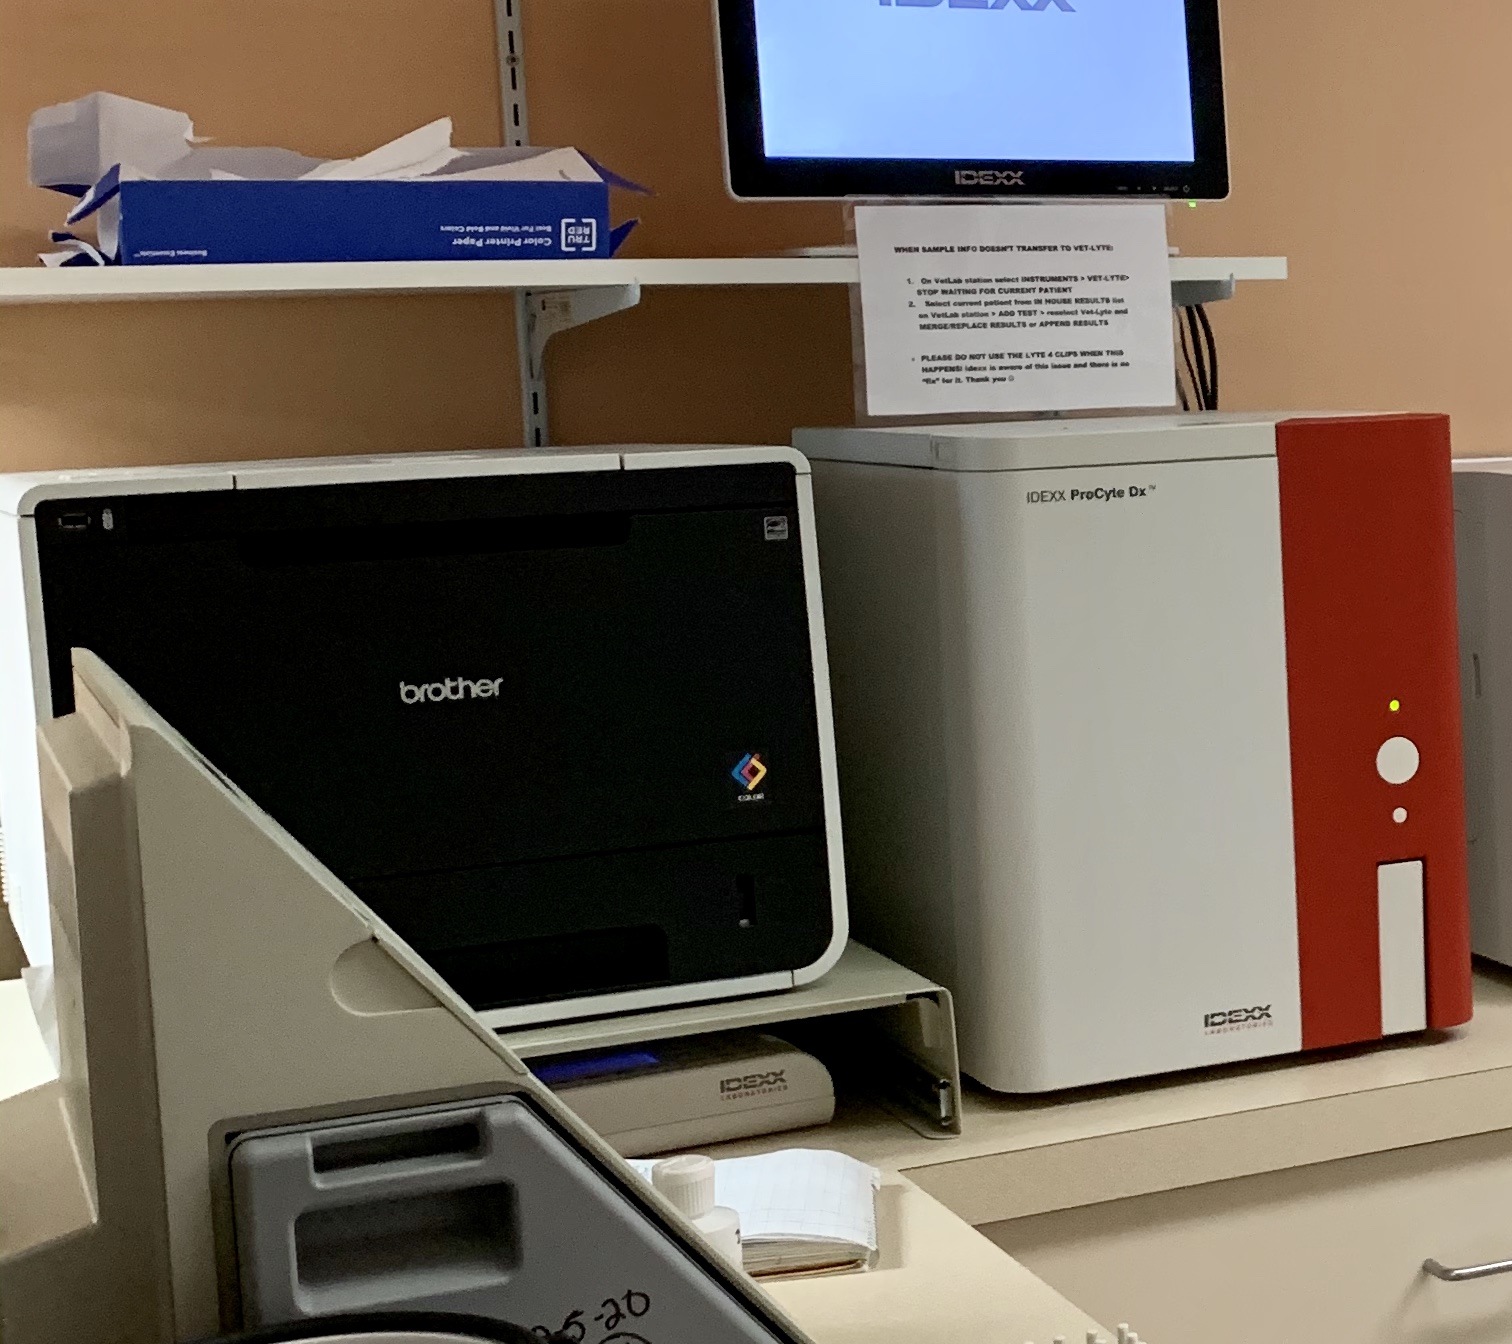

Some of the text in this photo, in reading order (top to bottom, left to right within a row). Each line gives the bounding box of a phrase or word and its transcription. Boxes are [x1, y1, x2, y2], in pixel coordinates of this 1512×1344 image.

[954, 170, 1026, 186] IDEXX
[567, 225, 591, 235] RED
[452, 236, 553, 248] Color Printer Paper
[567, 235, 591, 244] TRU
[894, 246, 920, 254] WHEN
[957, 245, 978, 253] INFO
[979, 245, 1014, 253] DOESN'T
[1060, 244, 1072, 252] TO
[920, 277, 932, 285] On
[1020, 275, 1079, 283] INSTRUMENTS
[916, 288, 939, 296] STOP
[979, 287, 996, 295] FOR
[997, 287, 1037, 295] CURRENT
[1038, 286, 1073, 294] PATIENT
[984, 299, 1012, 307] patient
[1044, 297, 1073, 305] HOUSE
[998, 309, 1016, 317] ADD
[1114, 307, 1129, 315] and
[990, 321, 1027, 329] RESULTS
[1039, 320, 1071, 328] APPEND
[921, 354, 953, 362] PLEASE
[1025, 351, 1046, 359] LYTE
[1055, 350, 1079, 358] CLIPS
[1034, 362, 1049, 370] this
[1073, 361, 1088, 369] and
[965, 375, 990, 383] Thank
[992, 376, 1007, 384] you
[1026, 490, 1066, 503] IDEXX
[1070, 487, 1125, 501] ProCyte
[399, 677, 504, 704] brother
[1204, 1004, 1272, 1027] IDEXX
[720, 1069, 786, 1093] IDEXX
